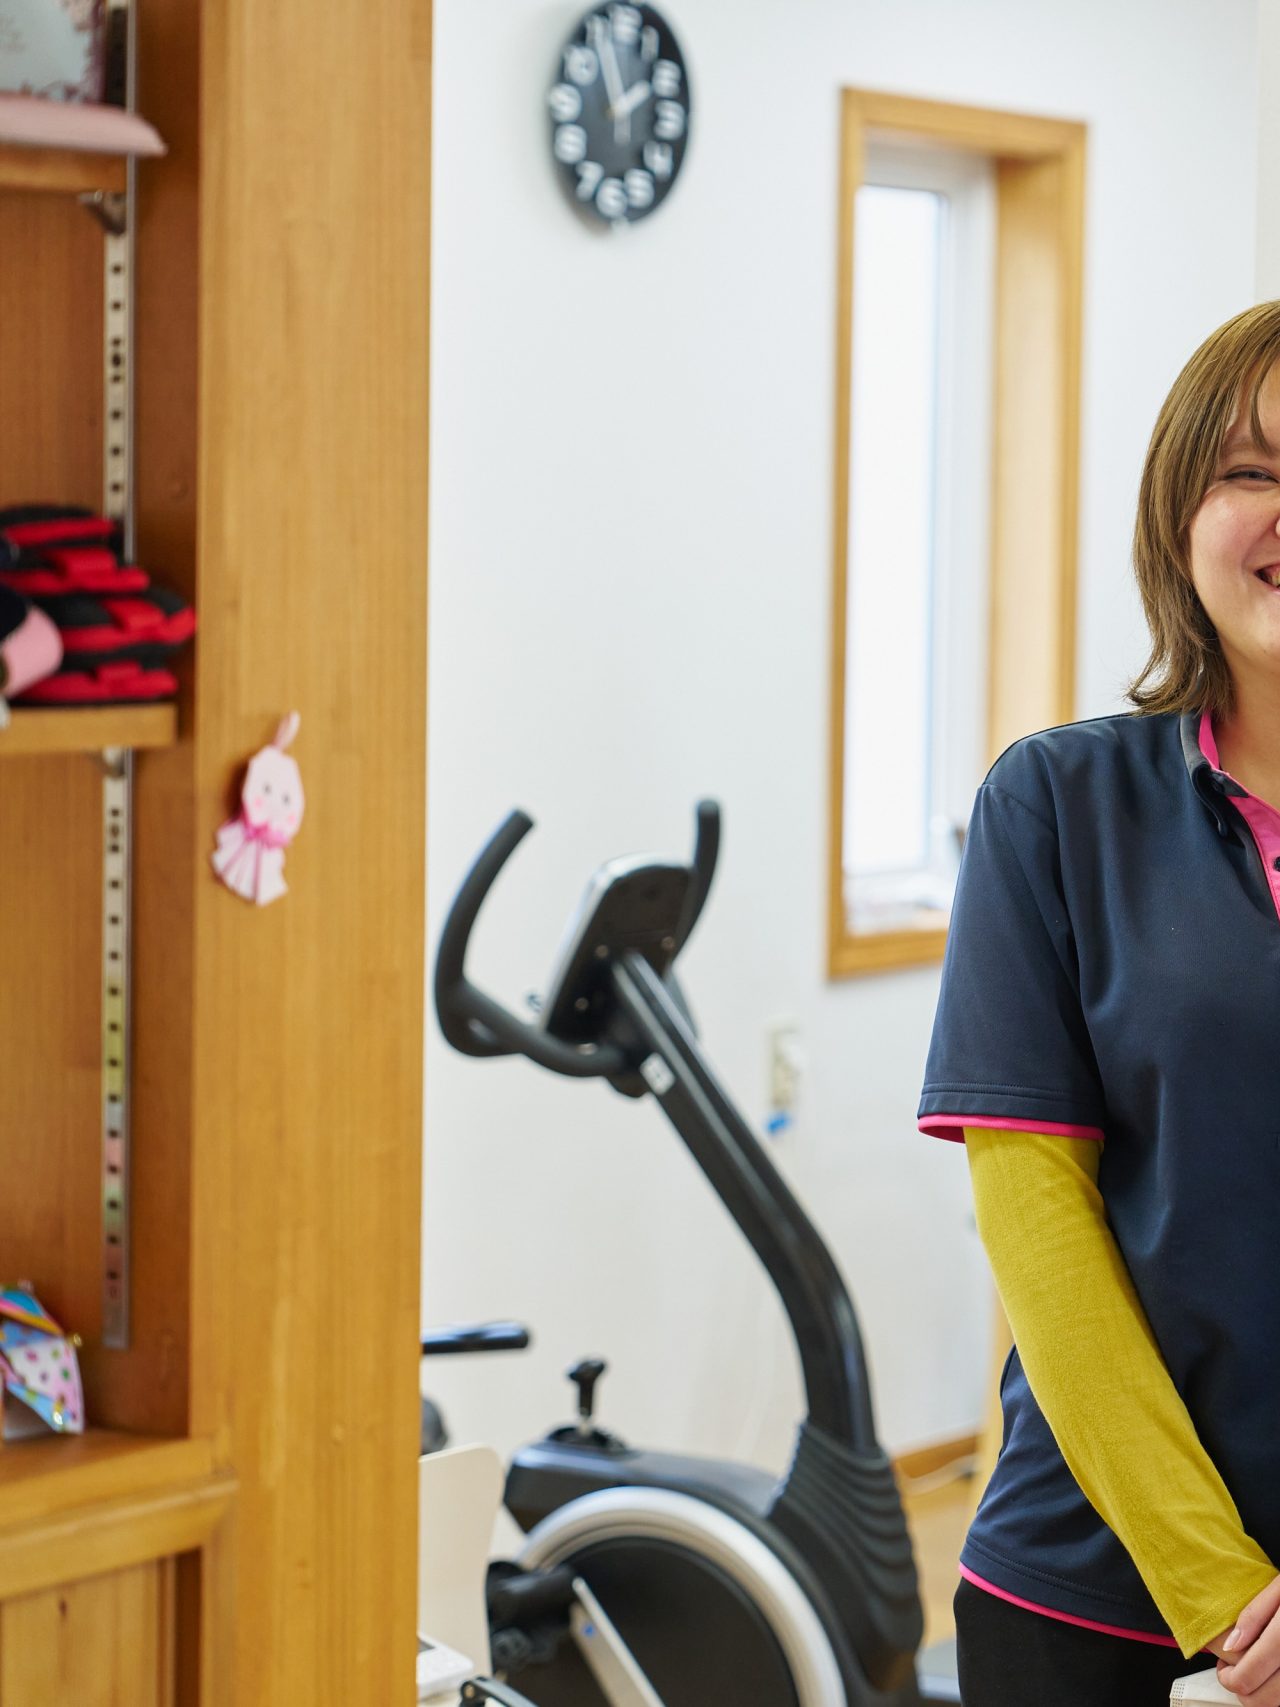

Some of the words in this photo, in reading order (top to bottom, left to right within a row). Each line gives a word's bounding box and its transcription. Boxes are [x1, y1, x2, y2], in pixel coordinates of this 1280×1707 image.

[655, 99, 685, 140] 3
[575, 160, 604, 202] 7
[643, 140, 673, 182] 4
